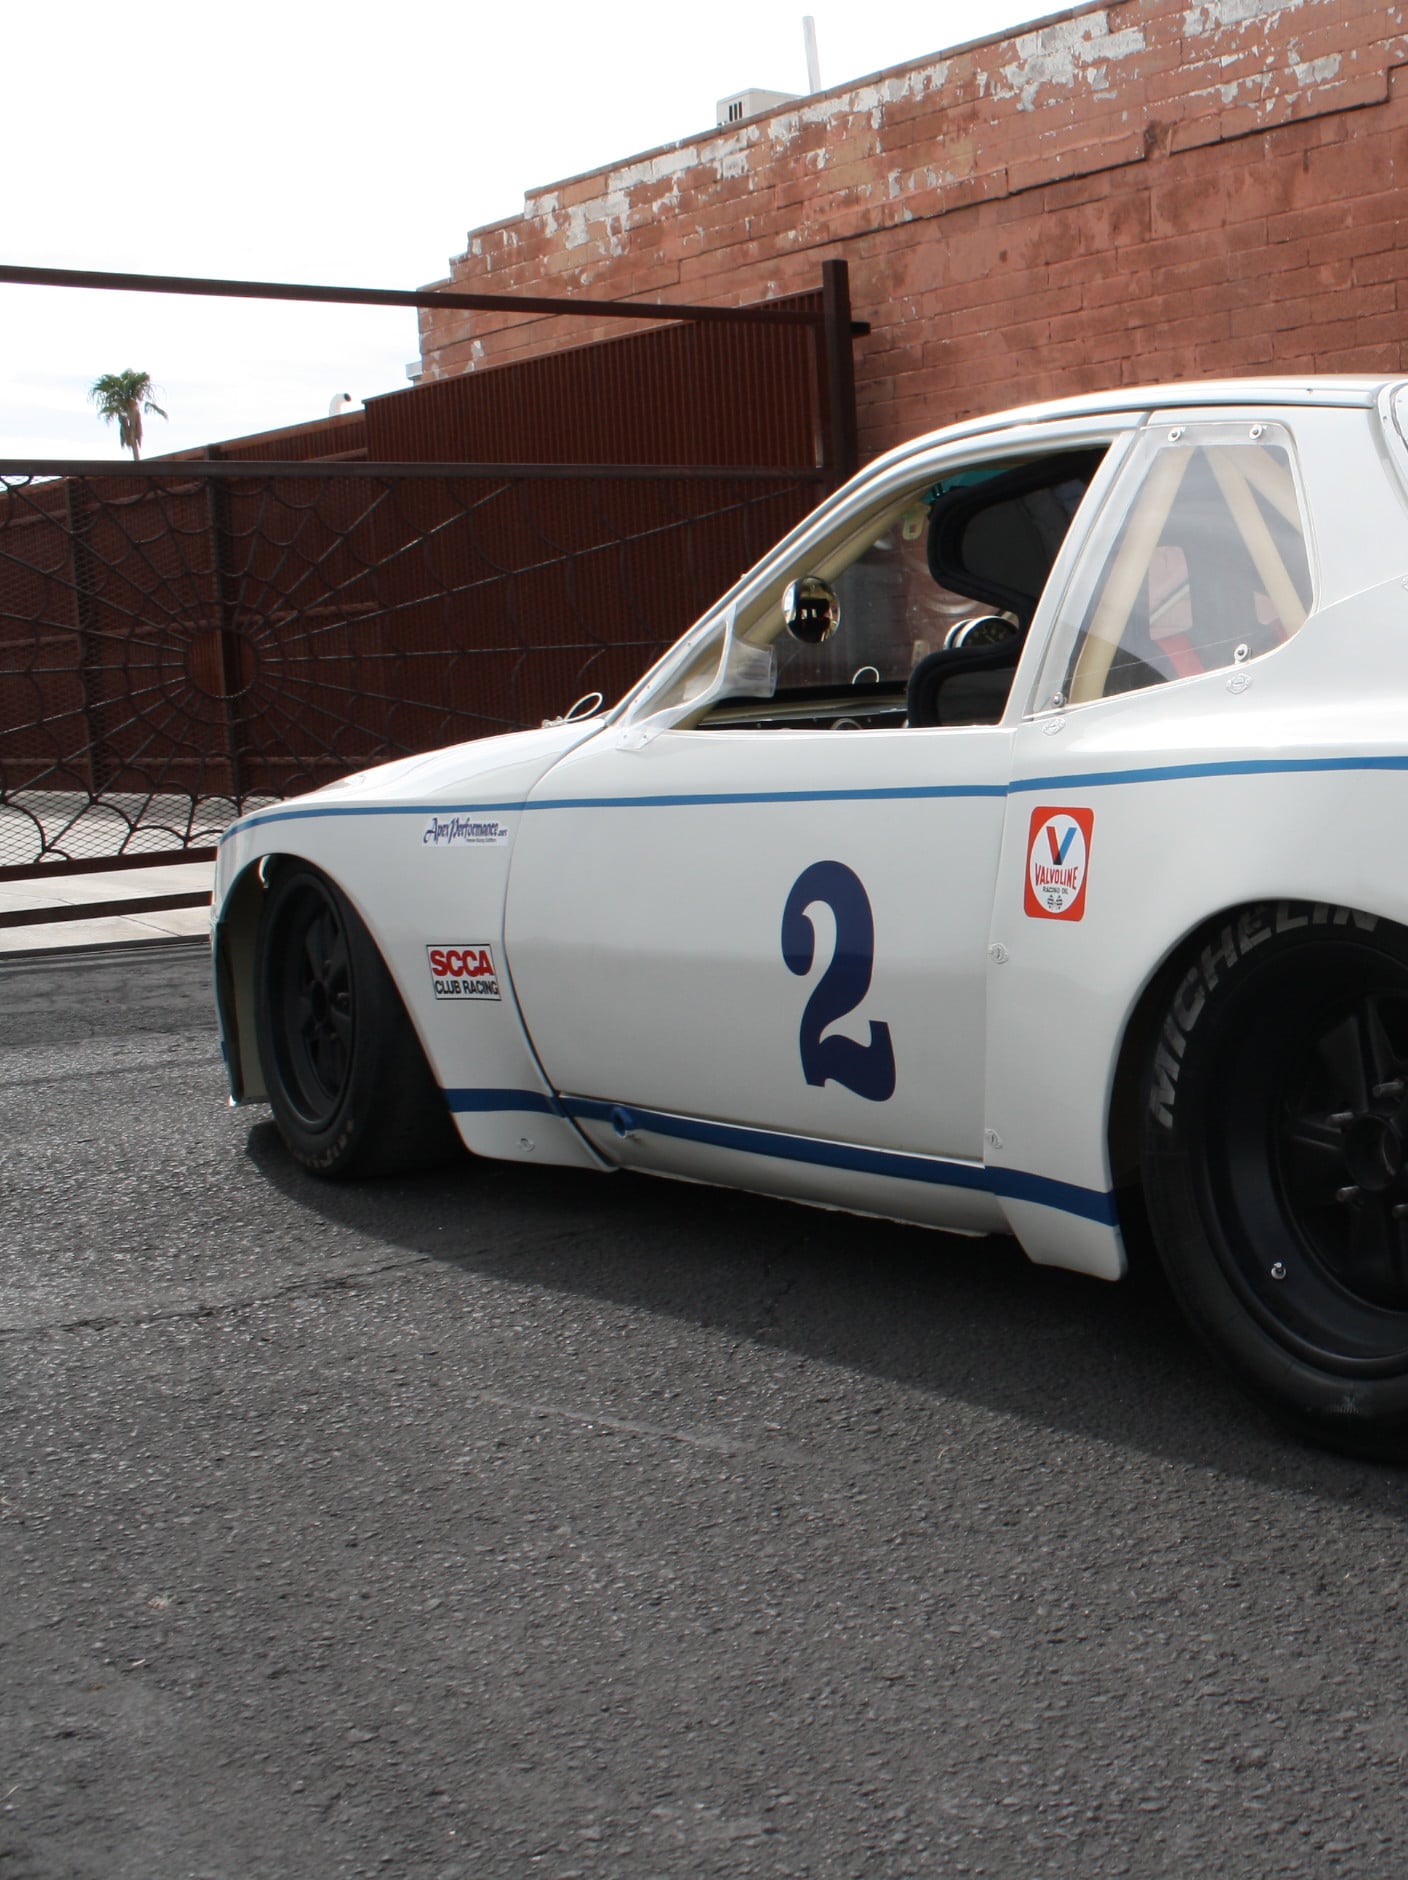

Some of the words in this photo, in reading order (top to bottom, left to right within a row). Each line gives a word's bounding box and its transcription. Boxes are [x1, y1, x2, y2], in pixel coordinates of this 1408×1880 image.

[1035, 862, 1079, 890] VALVOLINE
[430, 950, 496, 977] SCCA
[435, 981, 462, 994] CLUB
[462, 981, 499, 995] RACING
[782, 861, 896, 1102] 2
